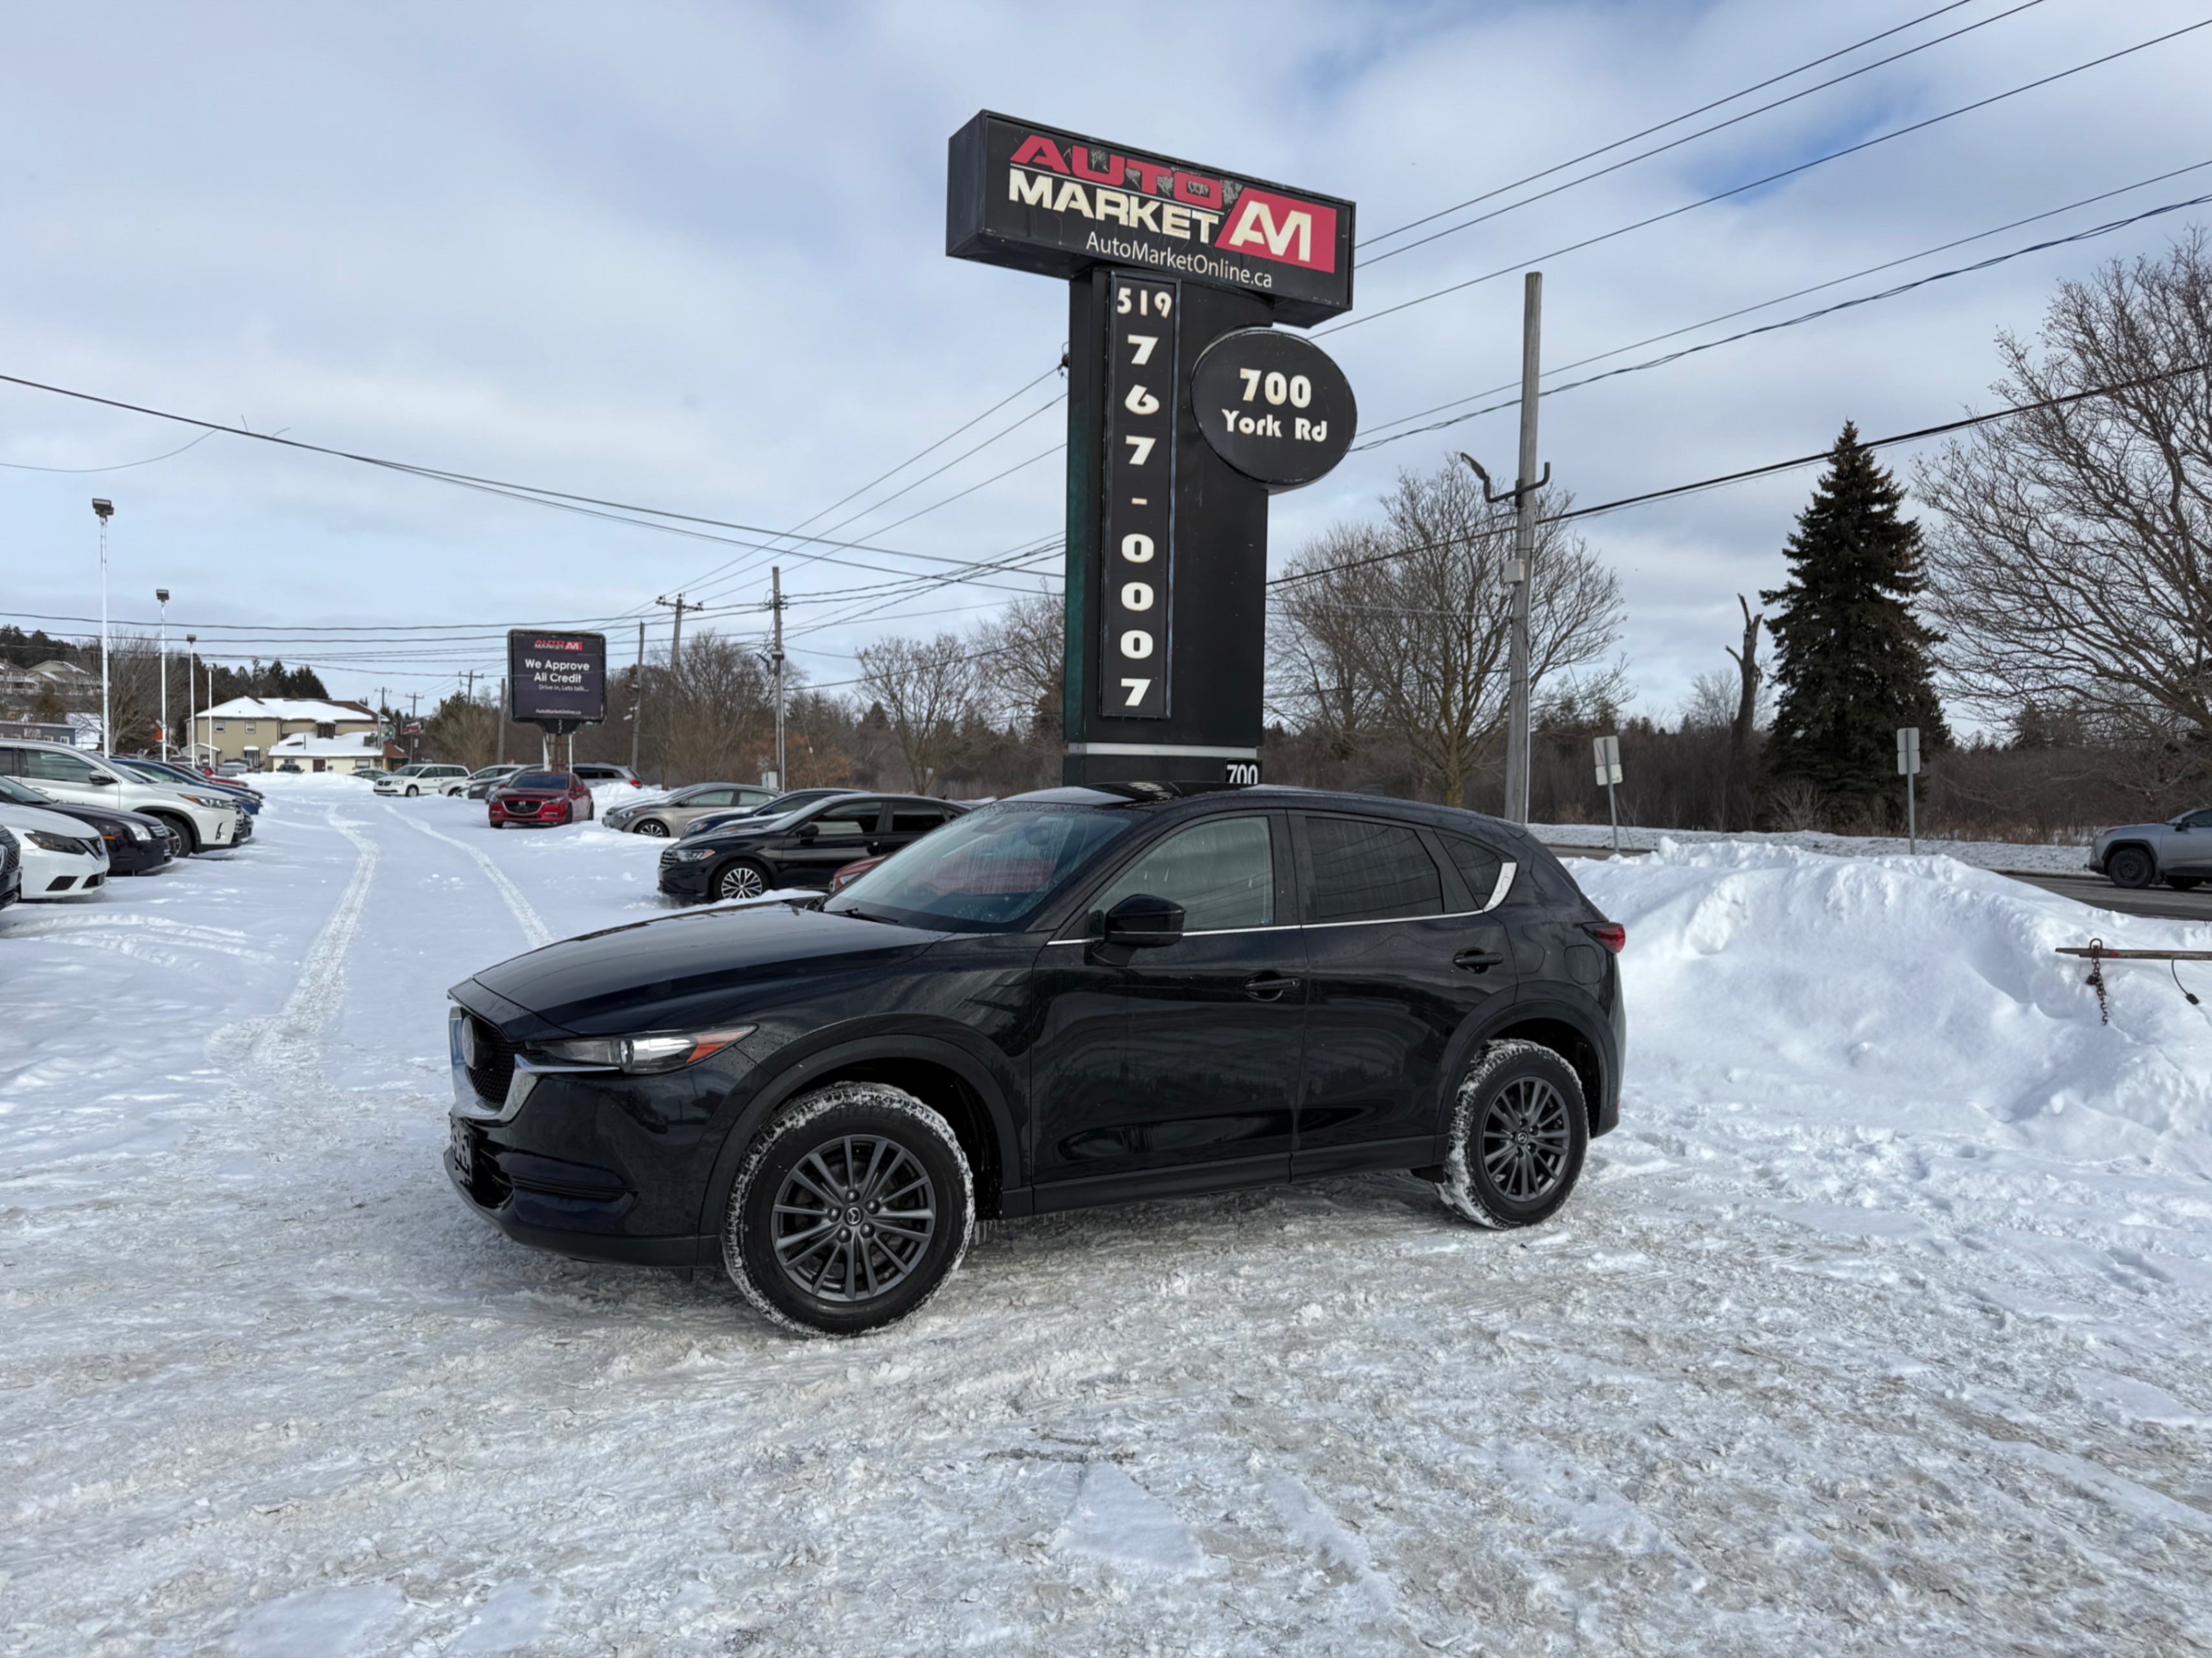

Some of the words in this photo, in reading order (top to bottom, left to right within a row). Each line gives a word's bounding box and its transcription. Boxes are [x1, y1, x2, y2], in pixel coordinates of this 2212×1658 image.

[1011, 135, 1223, 210] AUTO
[1009, 168, 1219, 245] MARKET
[1229, 200, 1312, 262] AM
[1086, 230, 1273, 288] AutoMarketOnline.ca
[1117, 287, 1172, 318] 519
[1240, 368, 1312, 409] 700
[1222, 409, 1282, 438] York
[1295, 417, 1328, 442] Rd
[524, 658, 542, 669] We
[544, 660, 590, 671] Approve
[533, 672, 547, 682] All
[549, 673, 582, 683] Credit
[1227, 764, 1259, 785] 700
